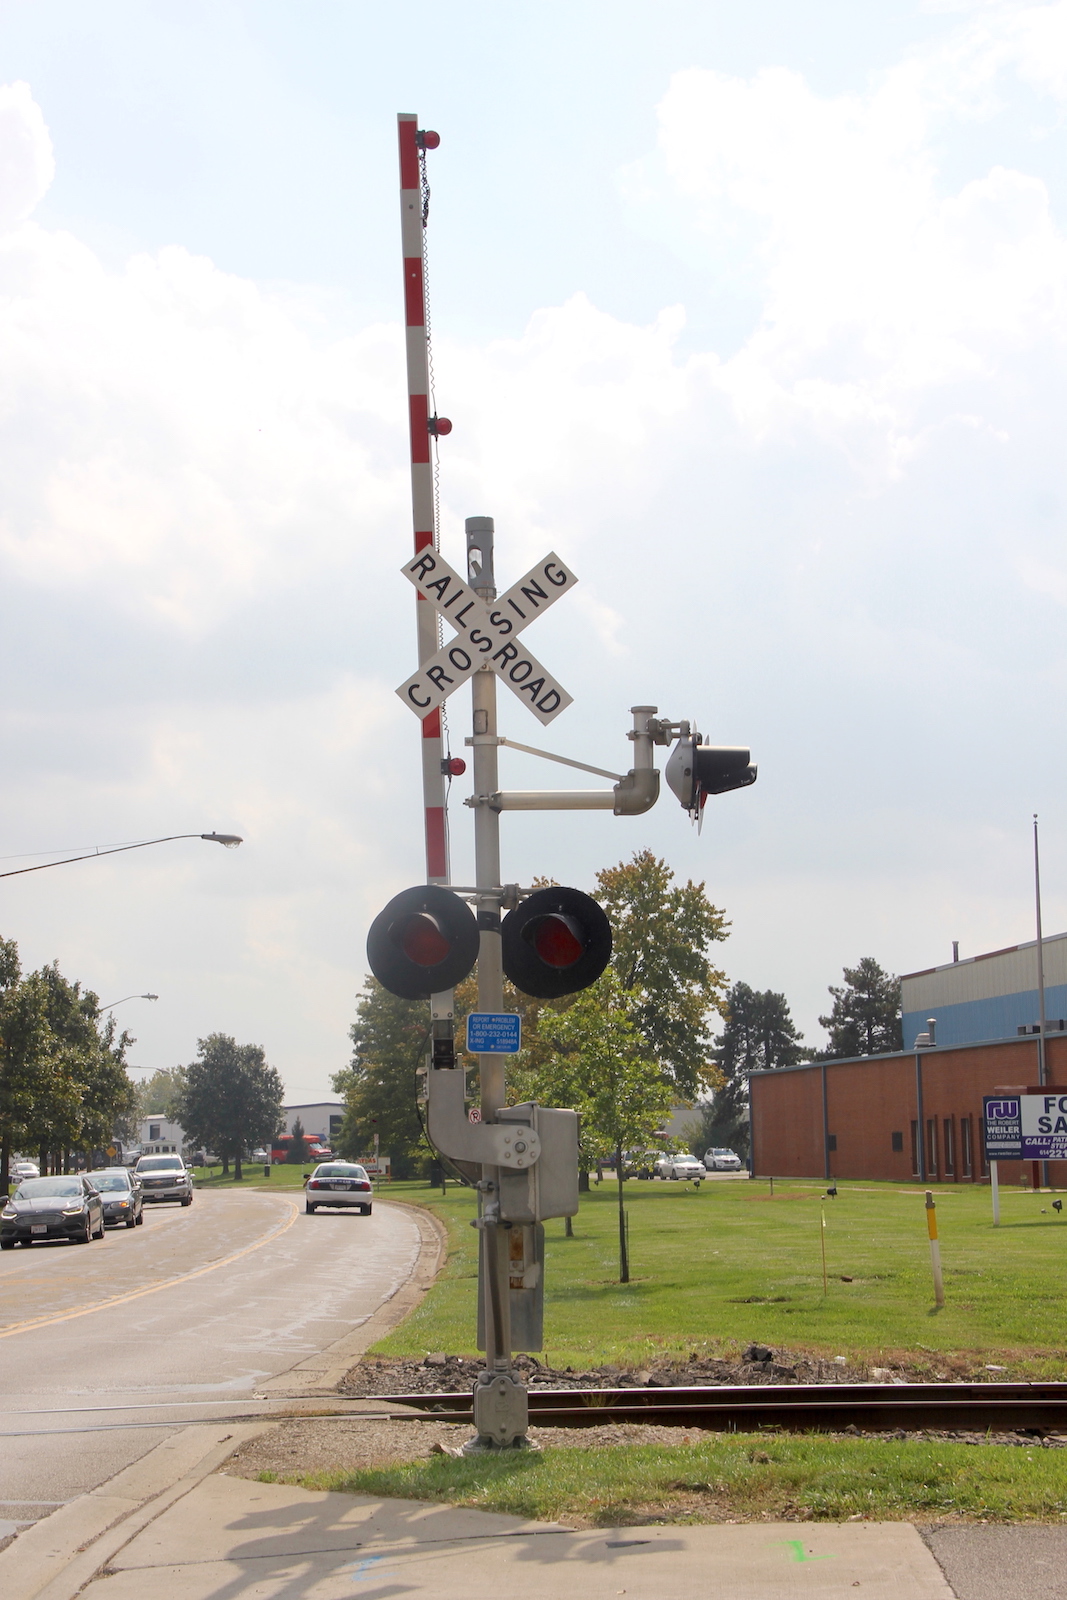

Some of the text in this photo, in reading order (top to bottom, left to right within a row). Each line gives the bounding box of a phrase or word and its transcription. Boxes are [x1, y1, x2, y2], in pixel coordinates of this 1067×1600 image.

[408, 563, 567, 708] CROSSING
[410, 553, 561, 714] RAIL ROAD
[470, 1030, 518, 1038] 1-800-232-0144
[986, 1126, 1020, 1134] WEILER
[1025, 1137, 1051, 1146] CALL:
